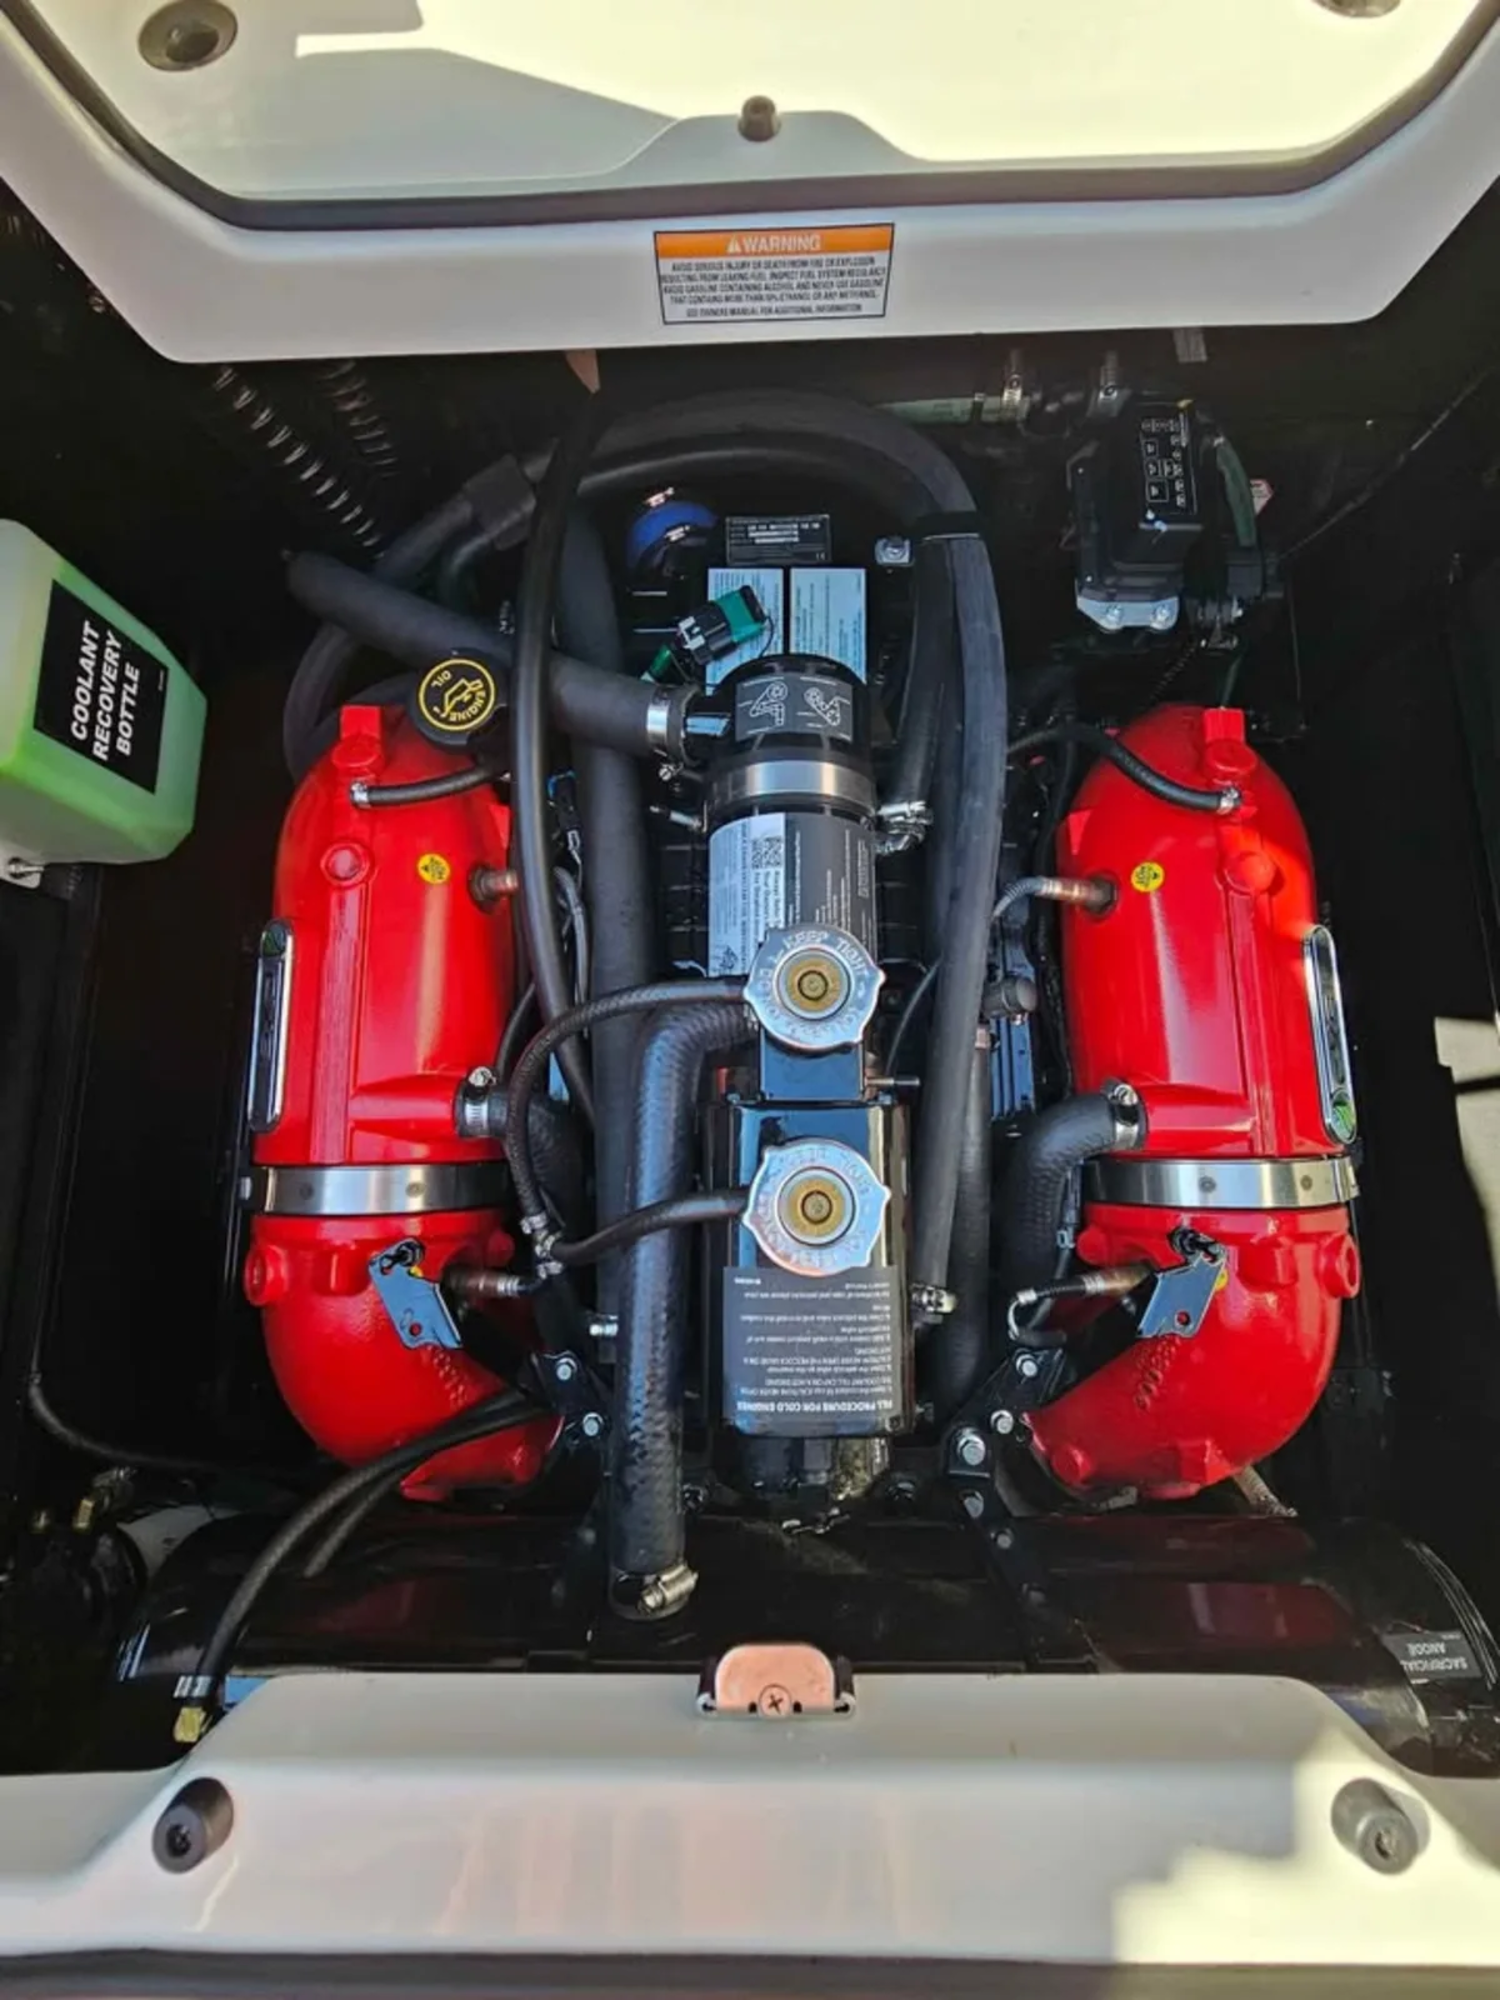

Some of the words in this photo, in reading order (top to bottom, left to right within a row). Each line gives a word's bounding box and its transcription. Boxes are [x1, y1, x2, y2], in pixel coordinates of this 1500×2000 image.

[742, 234, 821, 253] WARNING
[71, 620, 100, 741] COOLANT
[430, 670, 452, 688] OIL
[93, 630, 122, 761] RECOVERY
[116, 662, 140, 755] BOTTLE
[835, 937, 869, 976] TIGHT
[737, 1401, 775, 1412] ENGINES
[777, 1402, 801, 1412] COLD
[803, 1401, 821, 1411] FOR
[823, 1401, 876, 1411] PROCEDURE
[877, 1400, 892, 1410] FILL
[1407, 1642, 1446, 1657] ANODE
[1400, 1657, 1468, 1671] SACRIFICIAL
